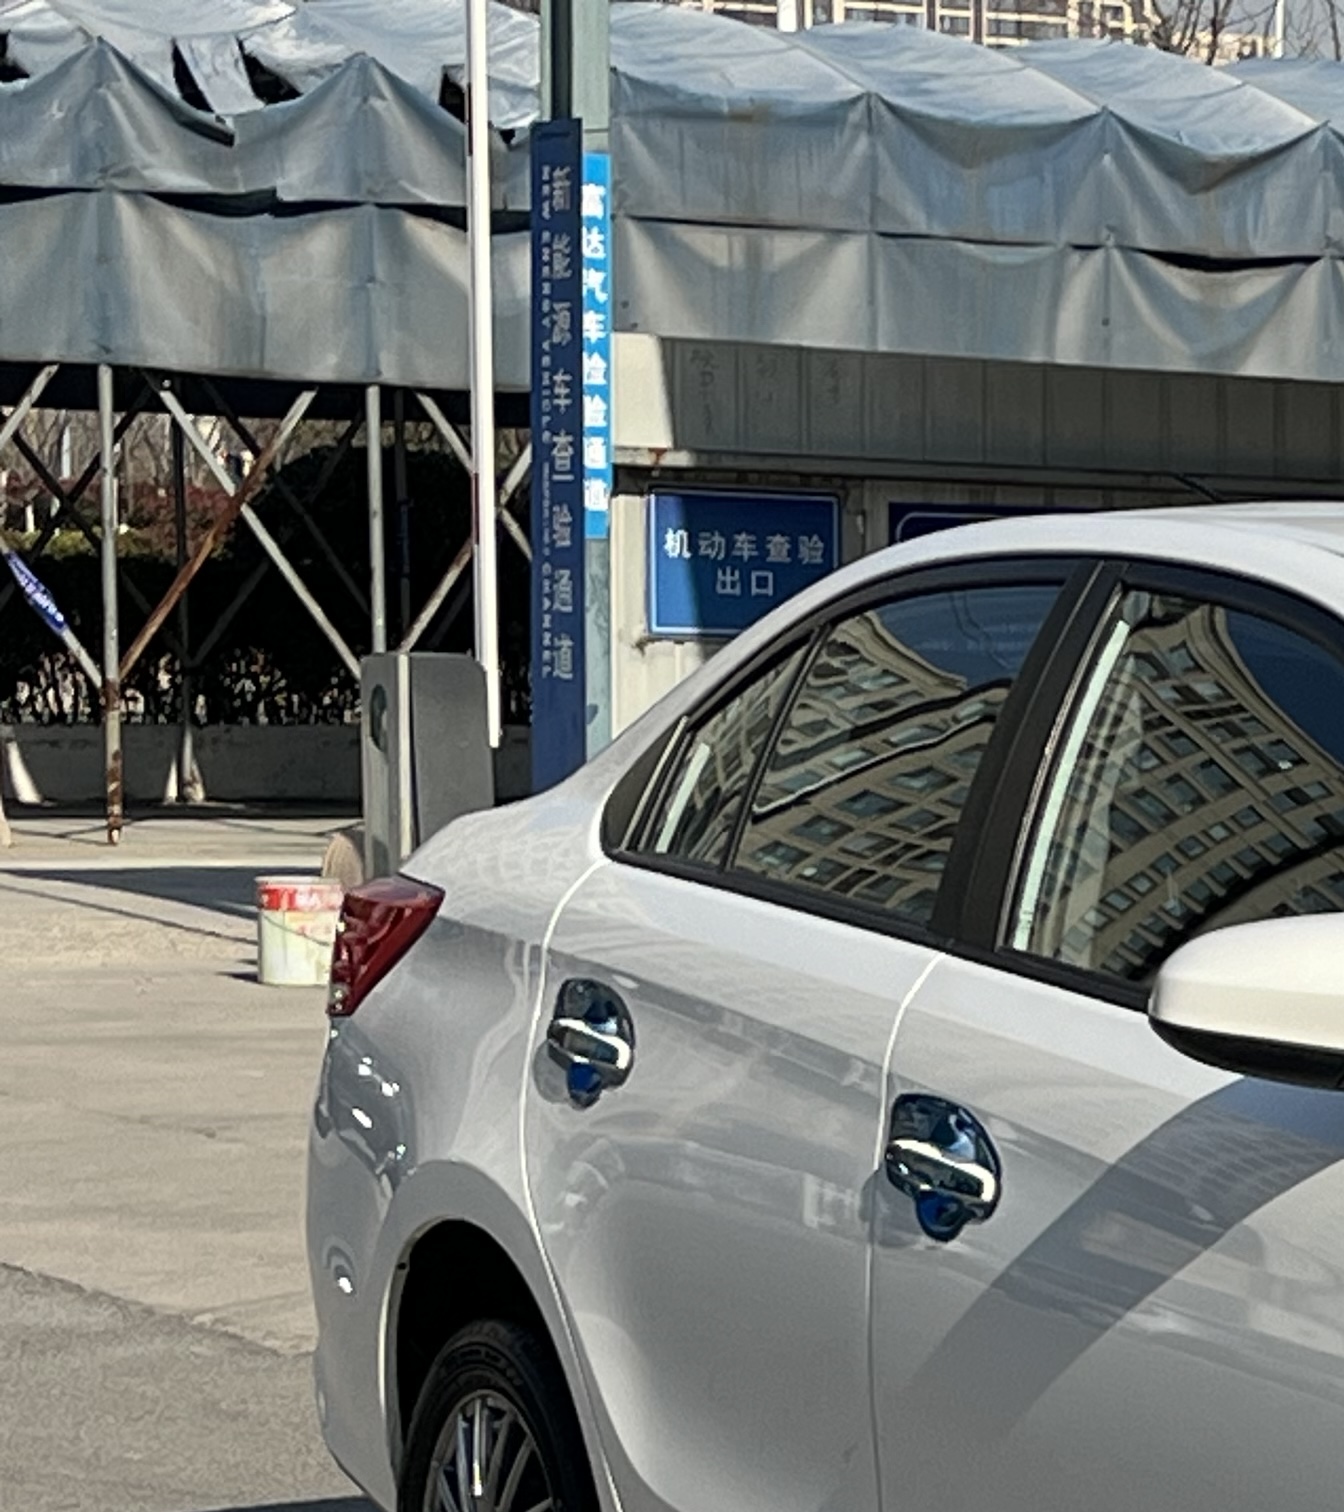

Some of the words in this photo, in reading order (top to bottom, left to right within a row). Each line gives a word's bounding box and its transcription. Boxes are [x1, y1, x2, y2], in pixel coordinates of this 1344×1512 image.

[541, 165, 551, 220] NEW
[551, 164, 574, 680] 新能源车查验通道
[663, 527, 825, 565] 机动车查验
[715, 566, 775, 597] 出口
